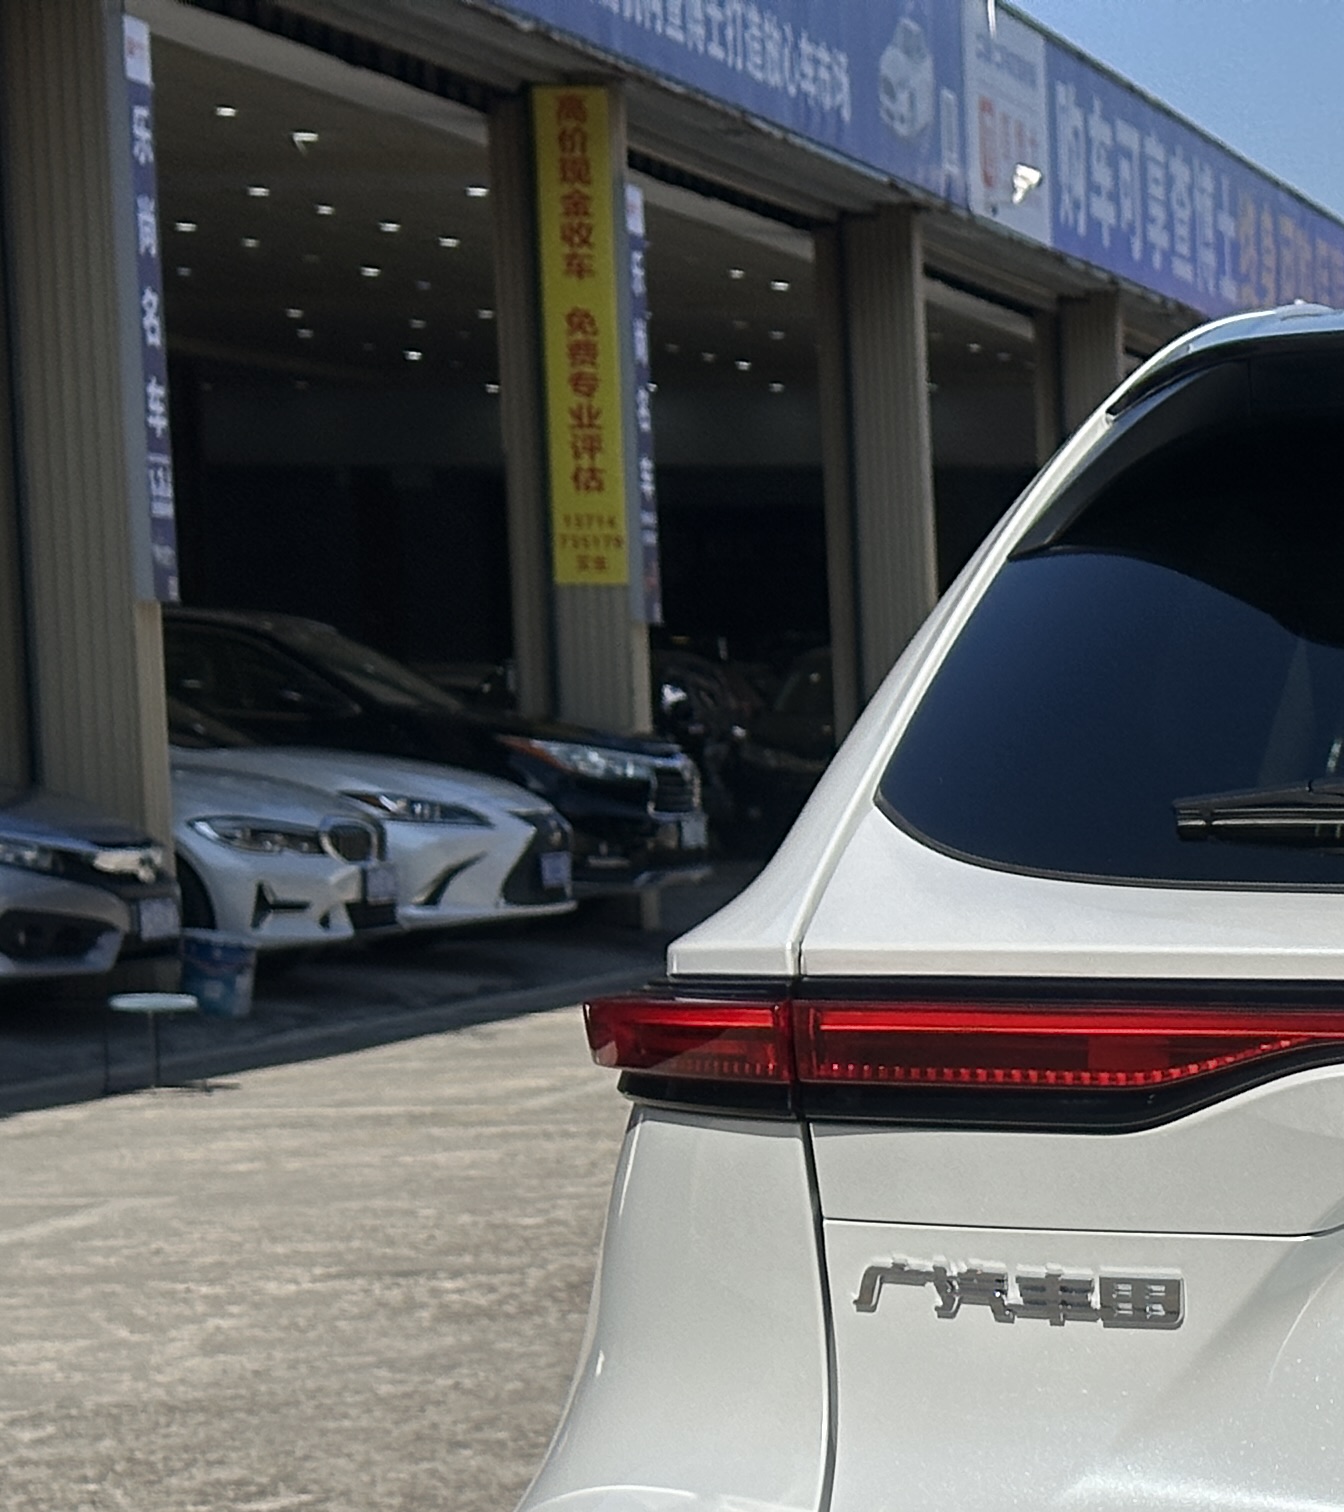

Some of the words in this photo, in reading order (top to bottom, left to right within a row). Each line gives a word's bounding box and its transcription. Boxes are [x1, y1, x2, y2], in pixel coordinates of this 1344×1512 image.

[555, 94, 596, 280] 高价现金收车
[564, 307, 606, 494] 免费专业评估
[853, 1255, 1187, 1330] 广汽丰田
